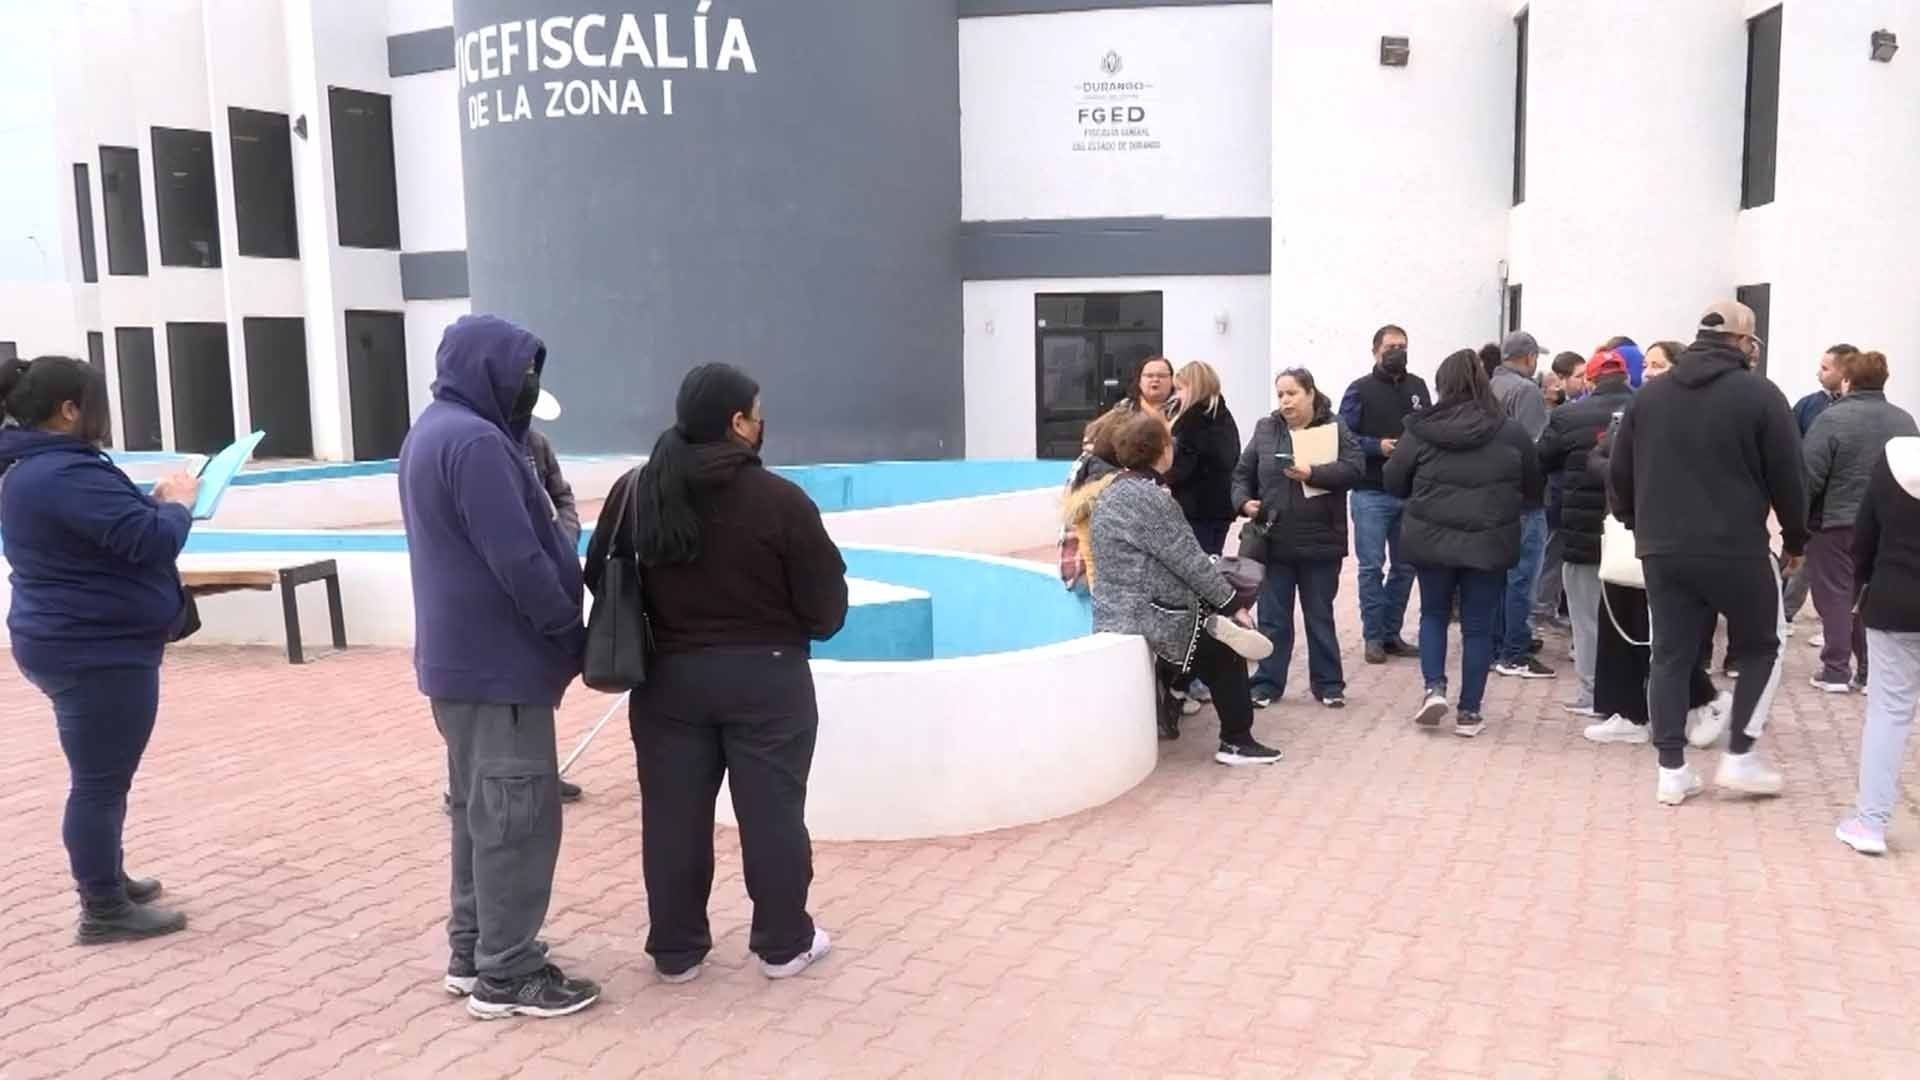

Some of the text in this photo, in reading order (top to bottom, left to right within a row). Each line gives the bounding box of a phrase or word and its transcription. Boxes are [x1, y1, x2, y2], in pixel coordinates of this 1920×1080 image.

[1083, 81, 1144, 93] DURANGO
[468, 79, 673, 129] DE LA ZONA I
[1078, 106, 1145, 124] FGED
